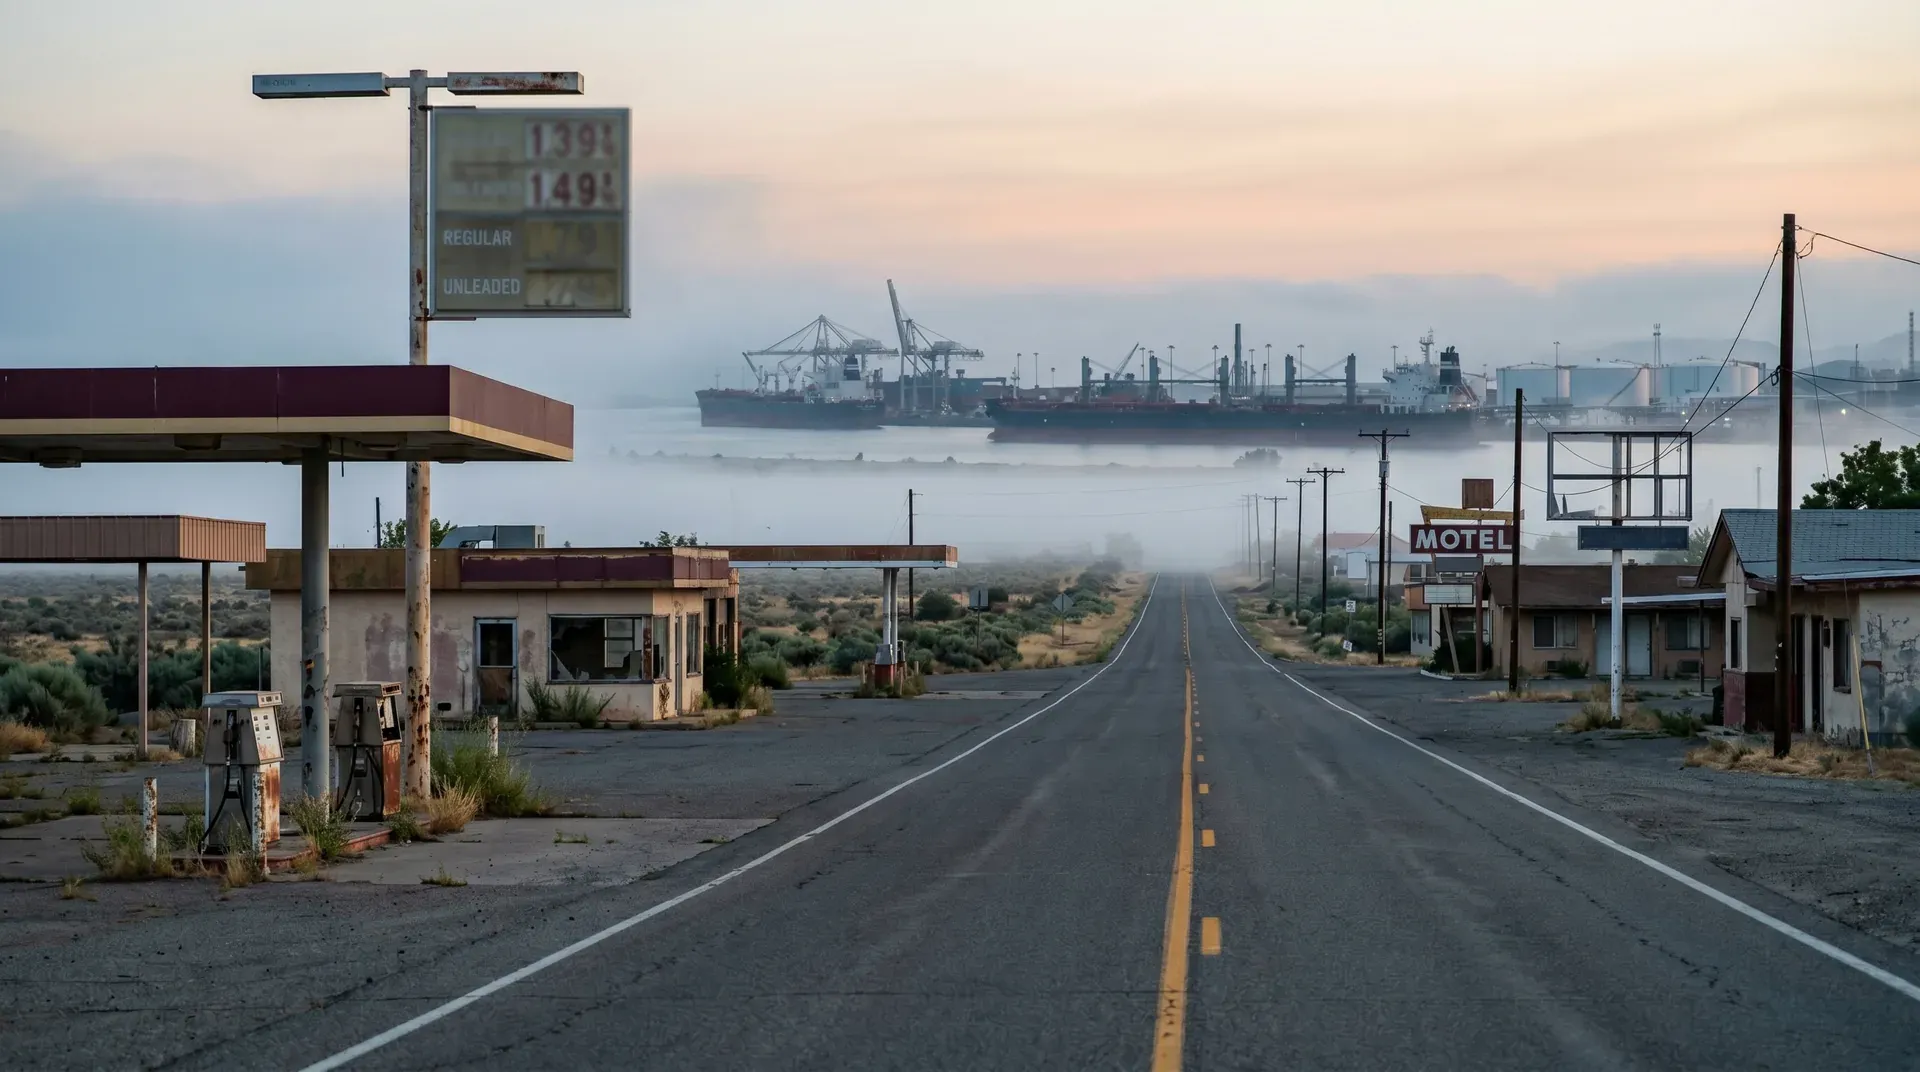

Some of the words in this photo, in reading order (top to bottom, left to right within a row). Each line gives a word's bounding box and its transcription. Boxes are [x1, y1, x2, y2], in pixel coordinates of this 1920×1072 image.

[443, 229, 512, 246] REGULAR
[443, 278, 521, 295] UNLEADED
[1415, 529, 1513, 549] MOTEL
